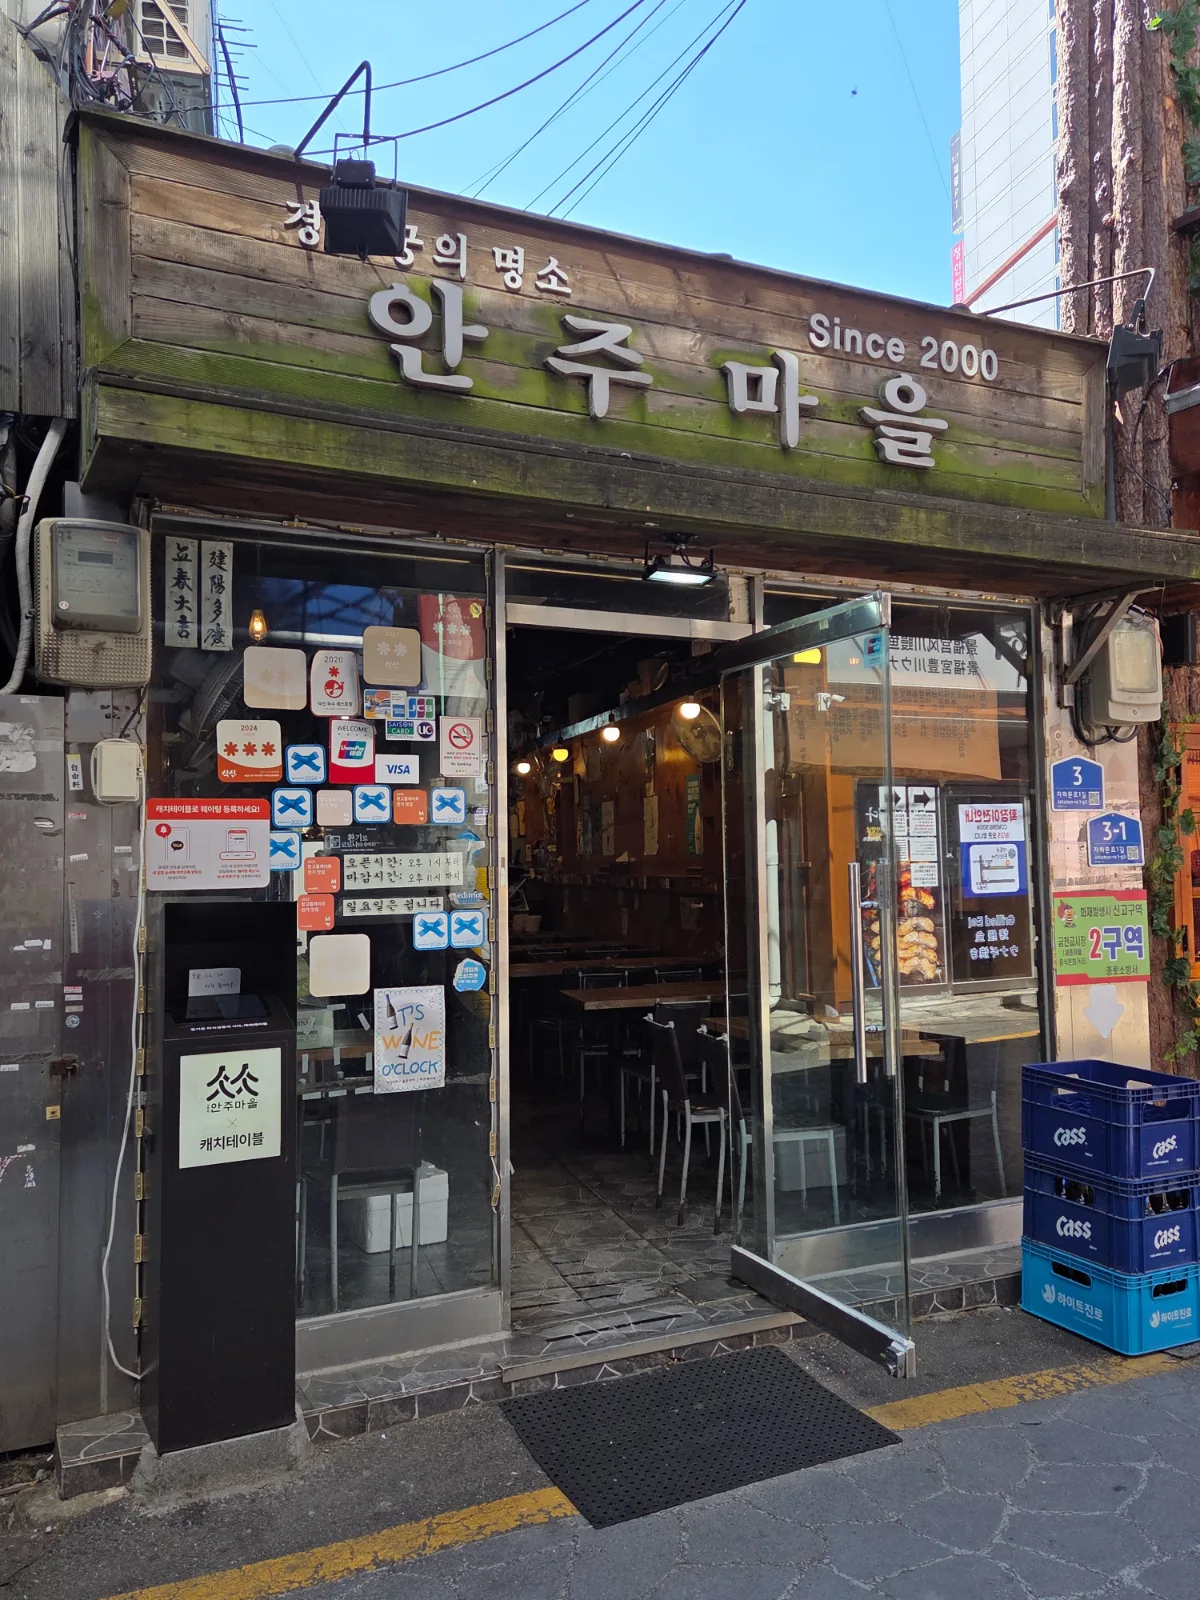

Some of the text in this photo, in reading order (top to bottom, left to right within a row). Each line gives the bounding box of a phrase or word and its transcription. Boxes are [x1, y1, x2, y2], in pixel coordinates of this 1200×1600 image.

[492, 245, 572, 297] 명소
[808, 313, 1000, 382] Since 2000
[367, 278, 949, 468] 안주마을
[324, 655, 344, 663] 2020
[408, 704, 434, 712] JCB
[337, 725, 368, 733] WELCOME
[391, 727, 410, 735] CARD
[418, 725, 433, 735] UC
[385, 764, 411, 775] VISA
[1072, 766, 1083, 786] 3
[1056, 791, 1087, 799] 자하문로1길
[155, 805, 260, 814] 캐치테이블로 웨이팅 등록하세요!
[1102, 821, 1127, 841] 3-1
[1093, 846, 1125, 854] 자하문로1길
[345, 856, 402, 869] 오픈시간:
[408, 858, 423, 868] 오후
[445, 857, 460, 866] 부터
[345, 871, 402, 884] 마감시간:
[408, 873, 424, 883] 오후
[445, 871, 460, 881] 까지
[346, 898, 442, 913] 일요일은 쉽니다
[1080, 903, 1143, 918] 화재발생시 신고구역
[1058, 935, 1086, 947] 금천교시장
[1089, 924, 1145, 962] 2구역
[1106, 965, 1138, 976] 종로소방서
[381, 1060, 438, 1077] O'CLOCK
[210, 1098, 259, 1113] 안주마을
[199, 1131, 264, 1151] 캐치테이블
[1053, 1126, 1088, 1147] Cass
[1152, 1134, 1178, 1160] Cass
[1055, 1215, 1092, 1240] Cass
[1154, 1225, 1181, 1250] Cass
[1057, 1291, 1104, 1322] 하이트진로
[1160, 1307, 1193, 1323] 하이트진로
